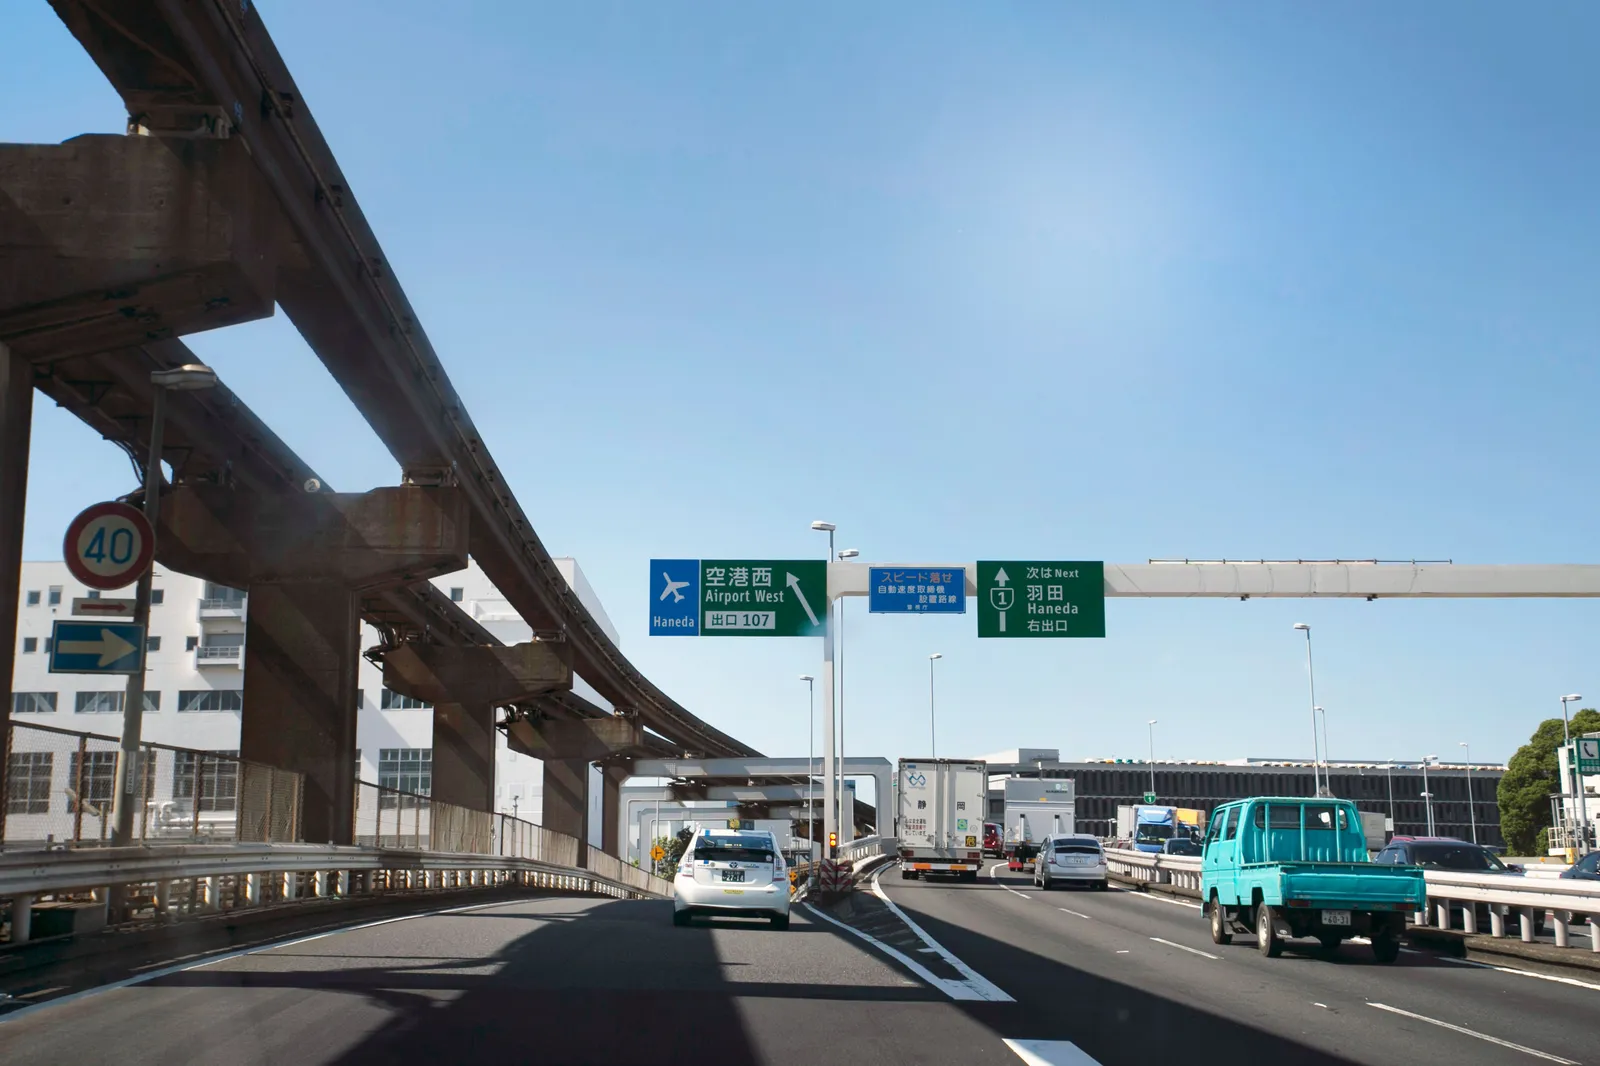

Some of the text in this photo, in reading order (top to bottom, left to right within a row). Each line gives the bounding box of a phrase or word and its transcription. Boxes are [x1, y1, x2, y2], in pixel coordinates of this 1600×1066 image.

[84, 527, 134, 564] 40
[705, 566, 772, 587] 空港西
[881, 571, 953, 583] スピード落せ
[1026, 567, 1079, 579] 次は Next
[705, 589, 784, 605] Airport West
[998, 591, 1007, 605] 1
[1026, 585, 1063, 601] 羽田
[1027, 602, 1079, 614] Haneda
[653, 616, 695, 627] Haneda
[711, 613, 769, 627] 出口 107
[1027, 619, 1067, 632] 右出口
